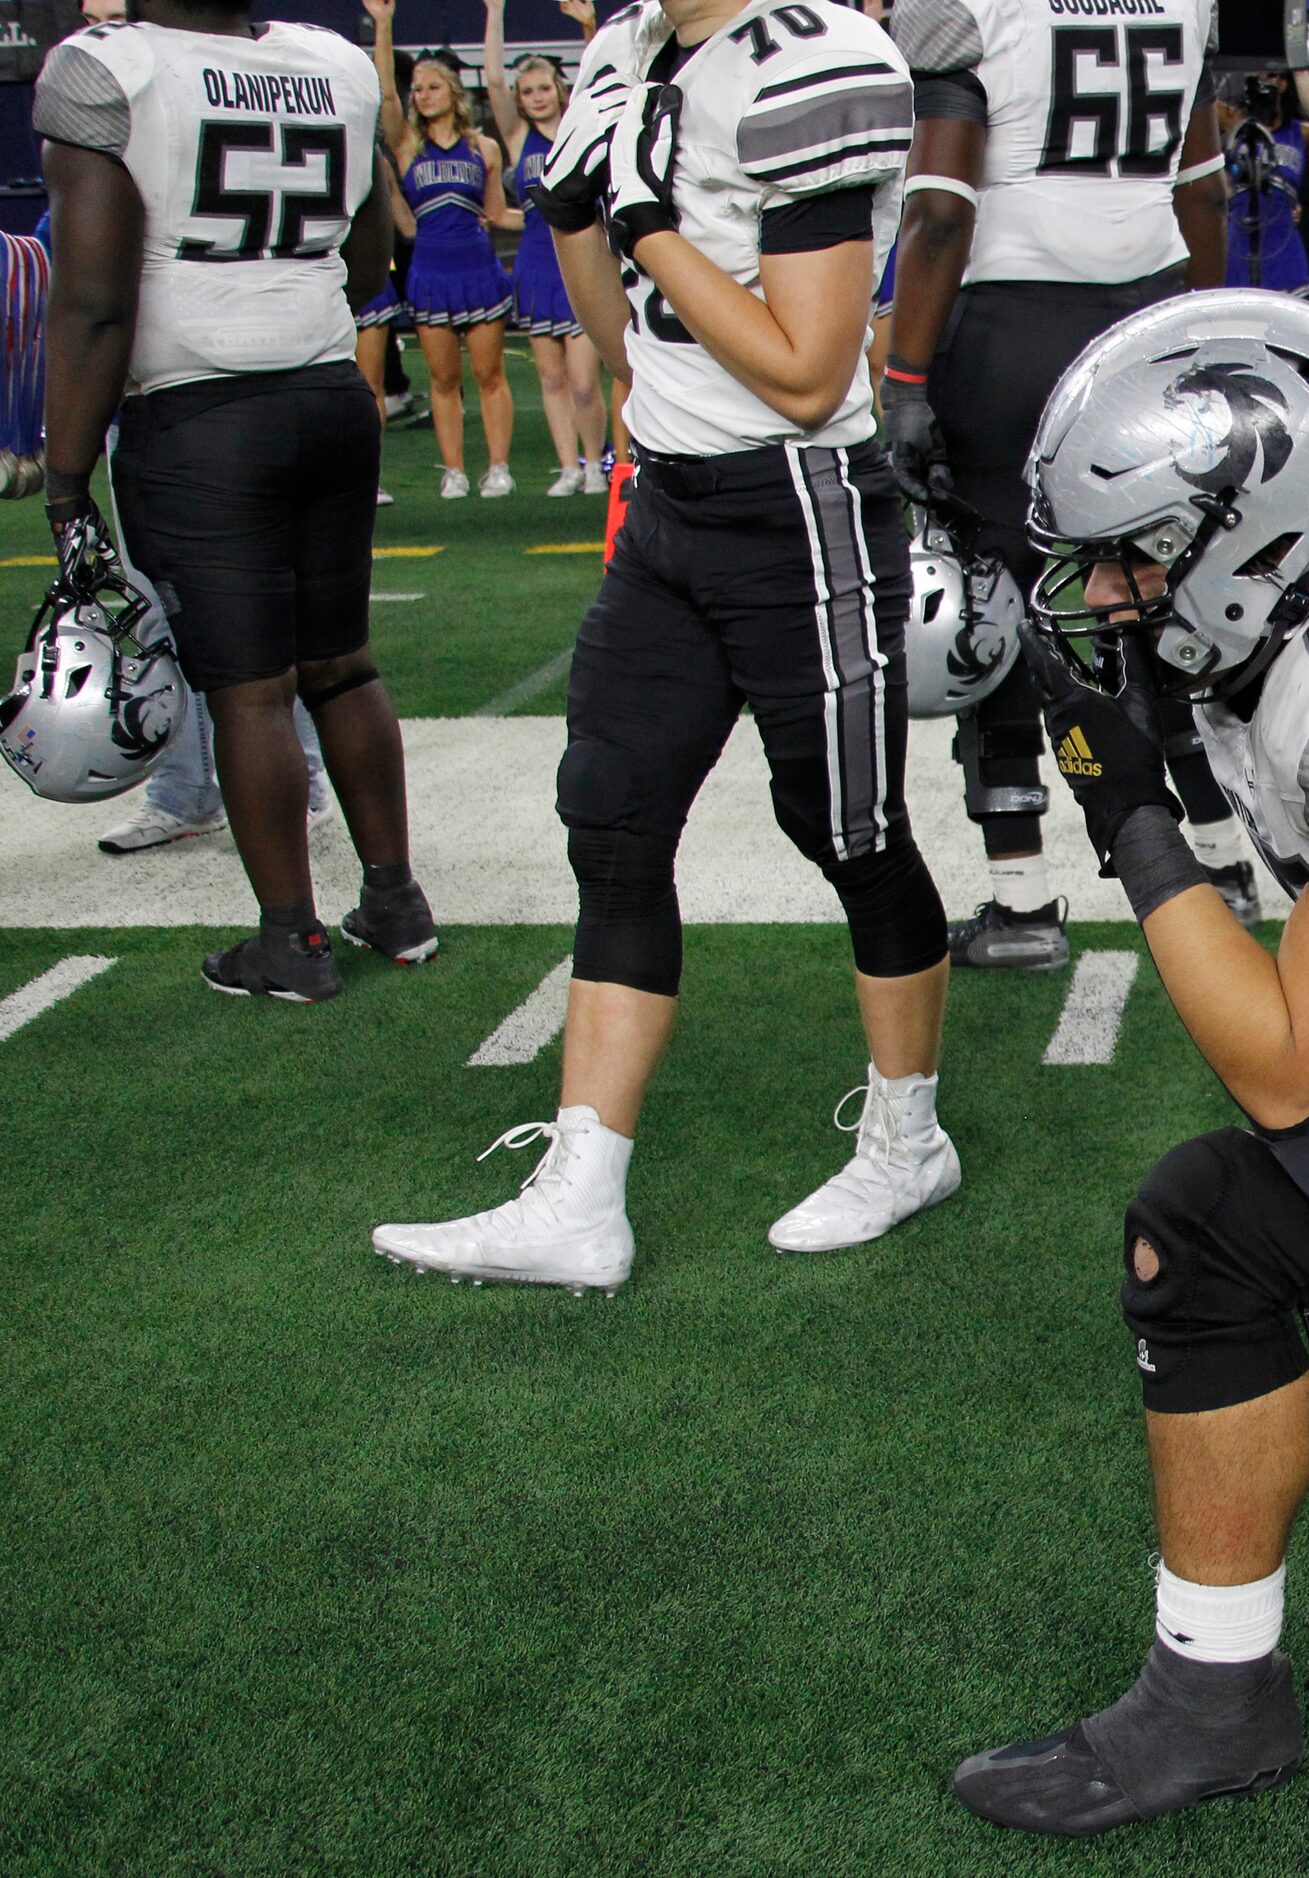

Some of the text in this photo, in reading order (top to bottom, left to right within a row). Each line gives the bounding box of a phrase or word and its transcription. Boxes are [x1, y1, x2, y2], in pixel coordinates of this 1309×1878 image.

[727, 4, 828, 66] 70
[203, 68, 336, 116] OLANIPEKUN
[1036, 24, 1185, 179] 66
[175, 119, 350, 263] 52
[1059, 757, 1102, 777] adidas
